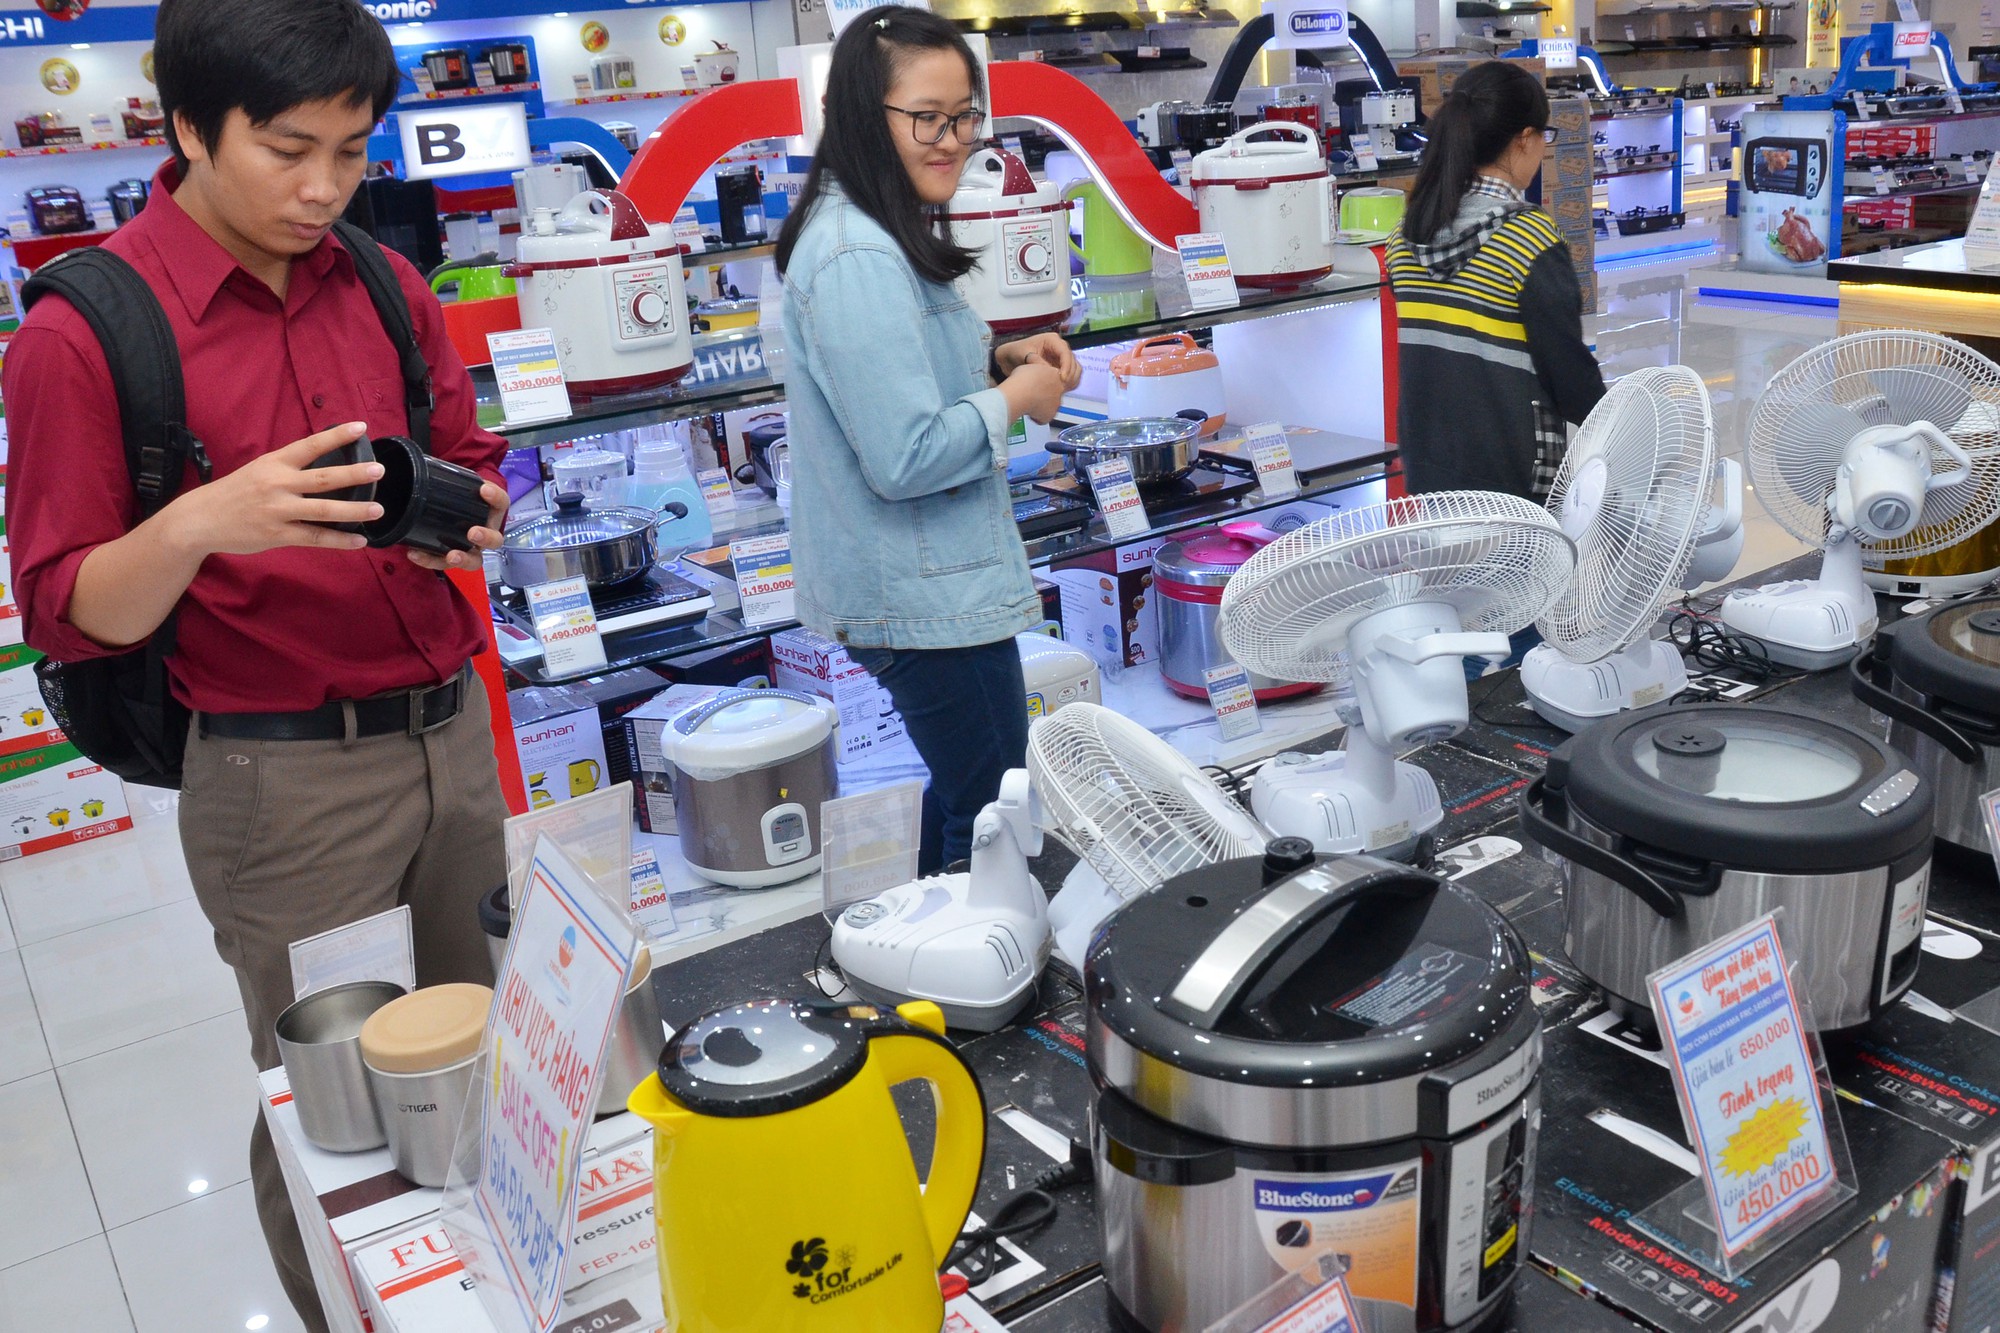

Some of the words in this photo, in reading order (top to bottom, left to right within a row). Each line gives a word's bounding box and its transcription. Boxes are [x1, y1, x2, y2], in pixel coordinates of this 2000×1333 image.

[501, 374, 563, 392] 1,390,000đ
[542, 623, 597, 643] 1.490.000đ
[775, 645, 812, 665] sunhan
[521, 725, 575, 746] sunhan
[501, 967, 532, 1038] KHU
[1739, 1017, 1791, 1060] 650,000
[407, 1103, 438, 1113] TIGER
[501, 1061, 531, 1154] SALE
[532, 1109, 558, 1189] OFF
[1259, 1188, 1354, 1208] BlueStone
[1554, 1175, 1615, 1214] Electric
[1737, 1153, 1821, 1225] 450.000
[809, 1266, 885, 1305] Comfortable
[885, 1250, 904, 1273] Life
[815, 1266, 853, 1292] for
